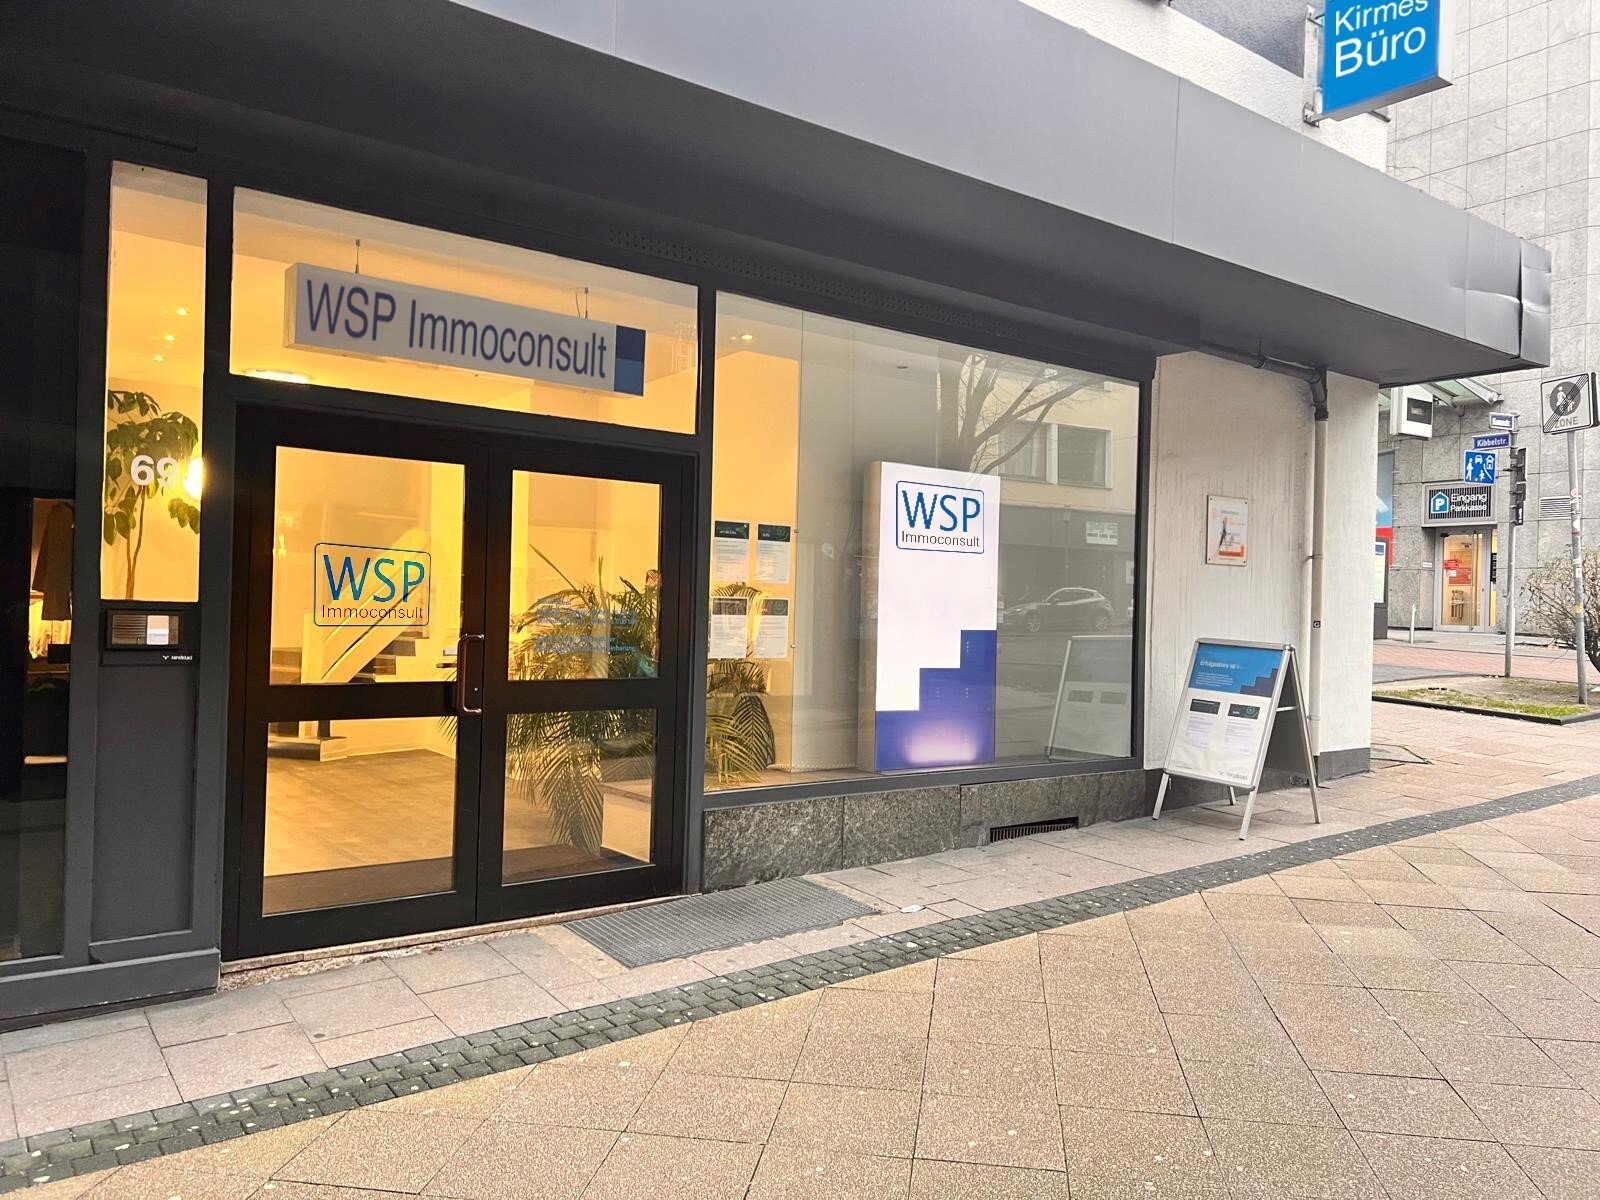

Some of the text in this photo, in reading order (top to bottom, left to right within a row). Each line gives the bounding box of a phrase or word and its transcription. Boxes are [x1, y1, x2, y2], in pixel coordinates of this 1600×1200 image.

[1335, 0, 1429, 36] Kirmes
[1335, 26, 1427, 78] Büro
[306, 279, 608, 379] WSP Immoconsult
[1476, 438, 1508, 447] Kibbelstr.
[130, 455, 178, 488] 69
[902, 489, 981, 533] WSP
[1435, 498, 1445, 511] P
[1450, 493, 1487, 504] Eingang
[1450, 504, 1487, 512] Parkkasse
[901, 530, 980, 547] Immoconsult
[322, 554, 425, 603] WSP
[321, 604, 423, 619] Immoconsult
